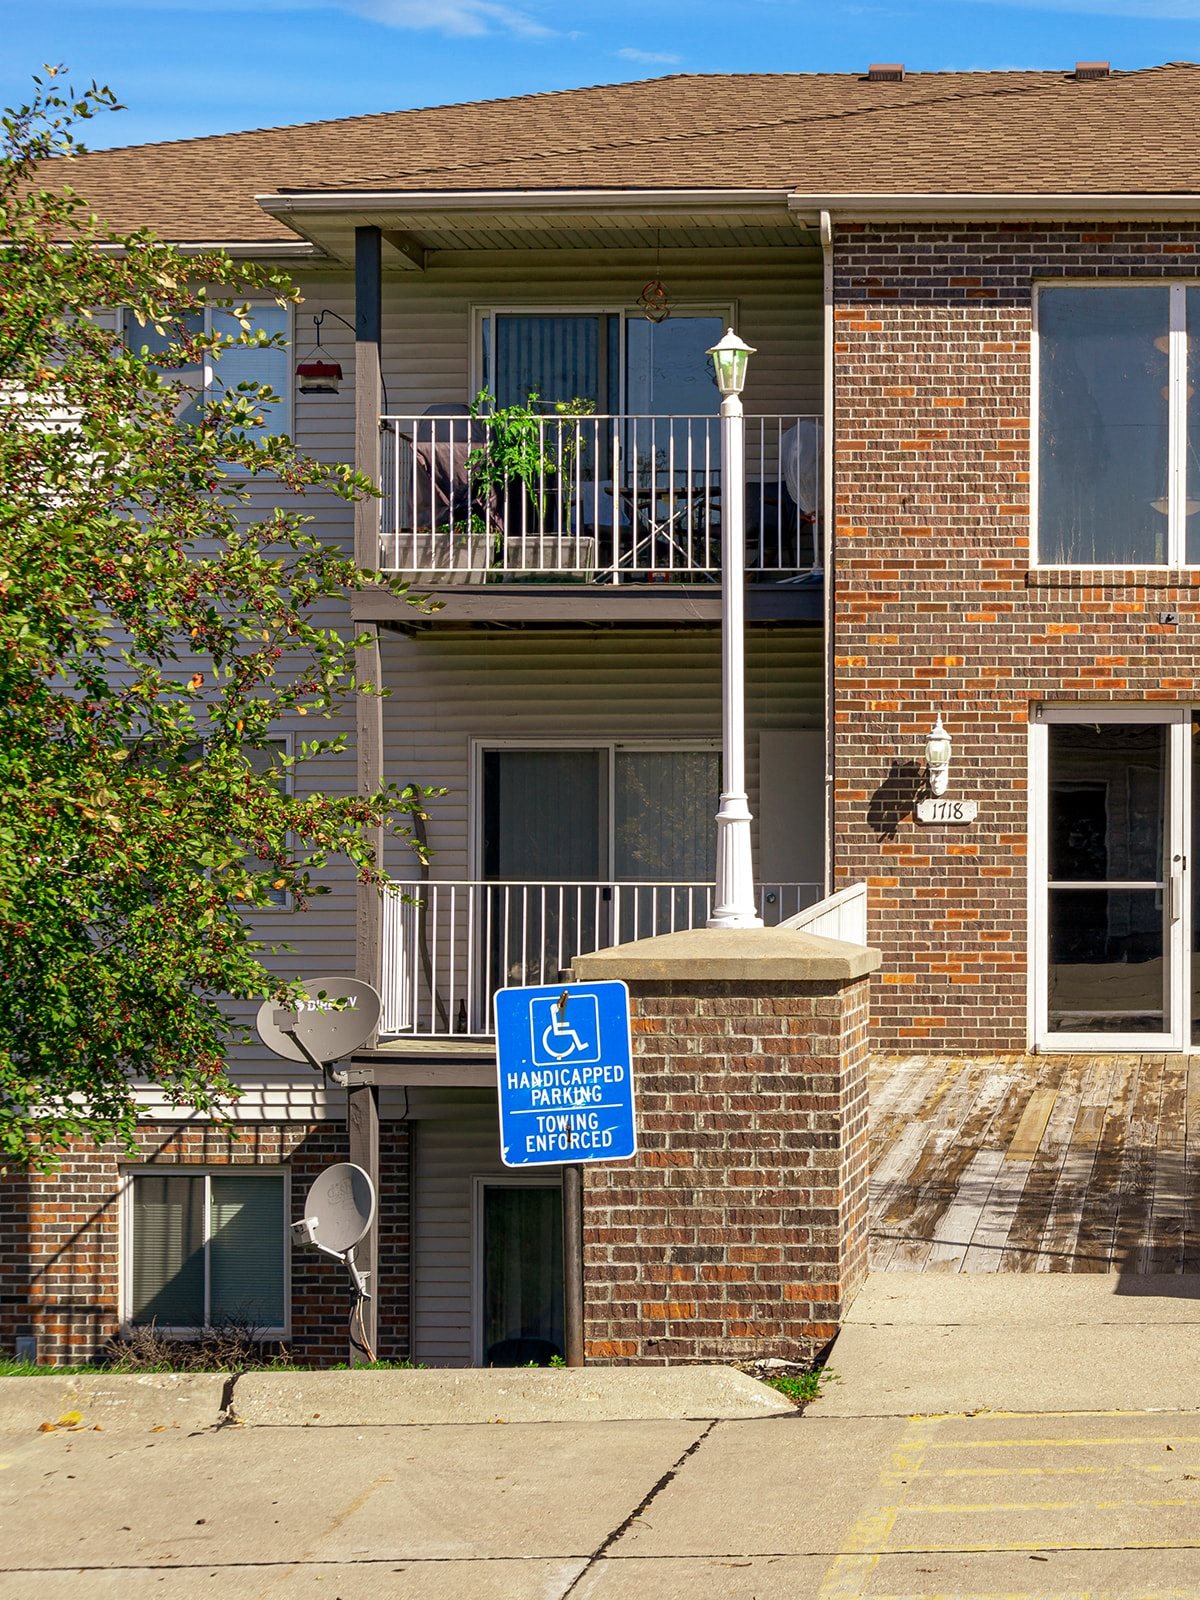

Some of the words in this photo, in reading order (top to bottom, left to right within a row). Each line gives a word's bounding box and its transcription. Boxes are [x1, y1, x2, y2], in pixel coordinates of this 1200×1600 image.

[932, 802, 964, 820] 1718
[307, 995, 358, 1011] DIEV
[507, 1065, 624, 1089] HANDICAPPED
[531, 1085, 602, 1106] PARKING
[536, 1112, 599, 1133] TOWING
[525, 1130, 613, 1153] ENFORCED
